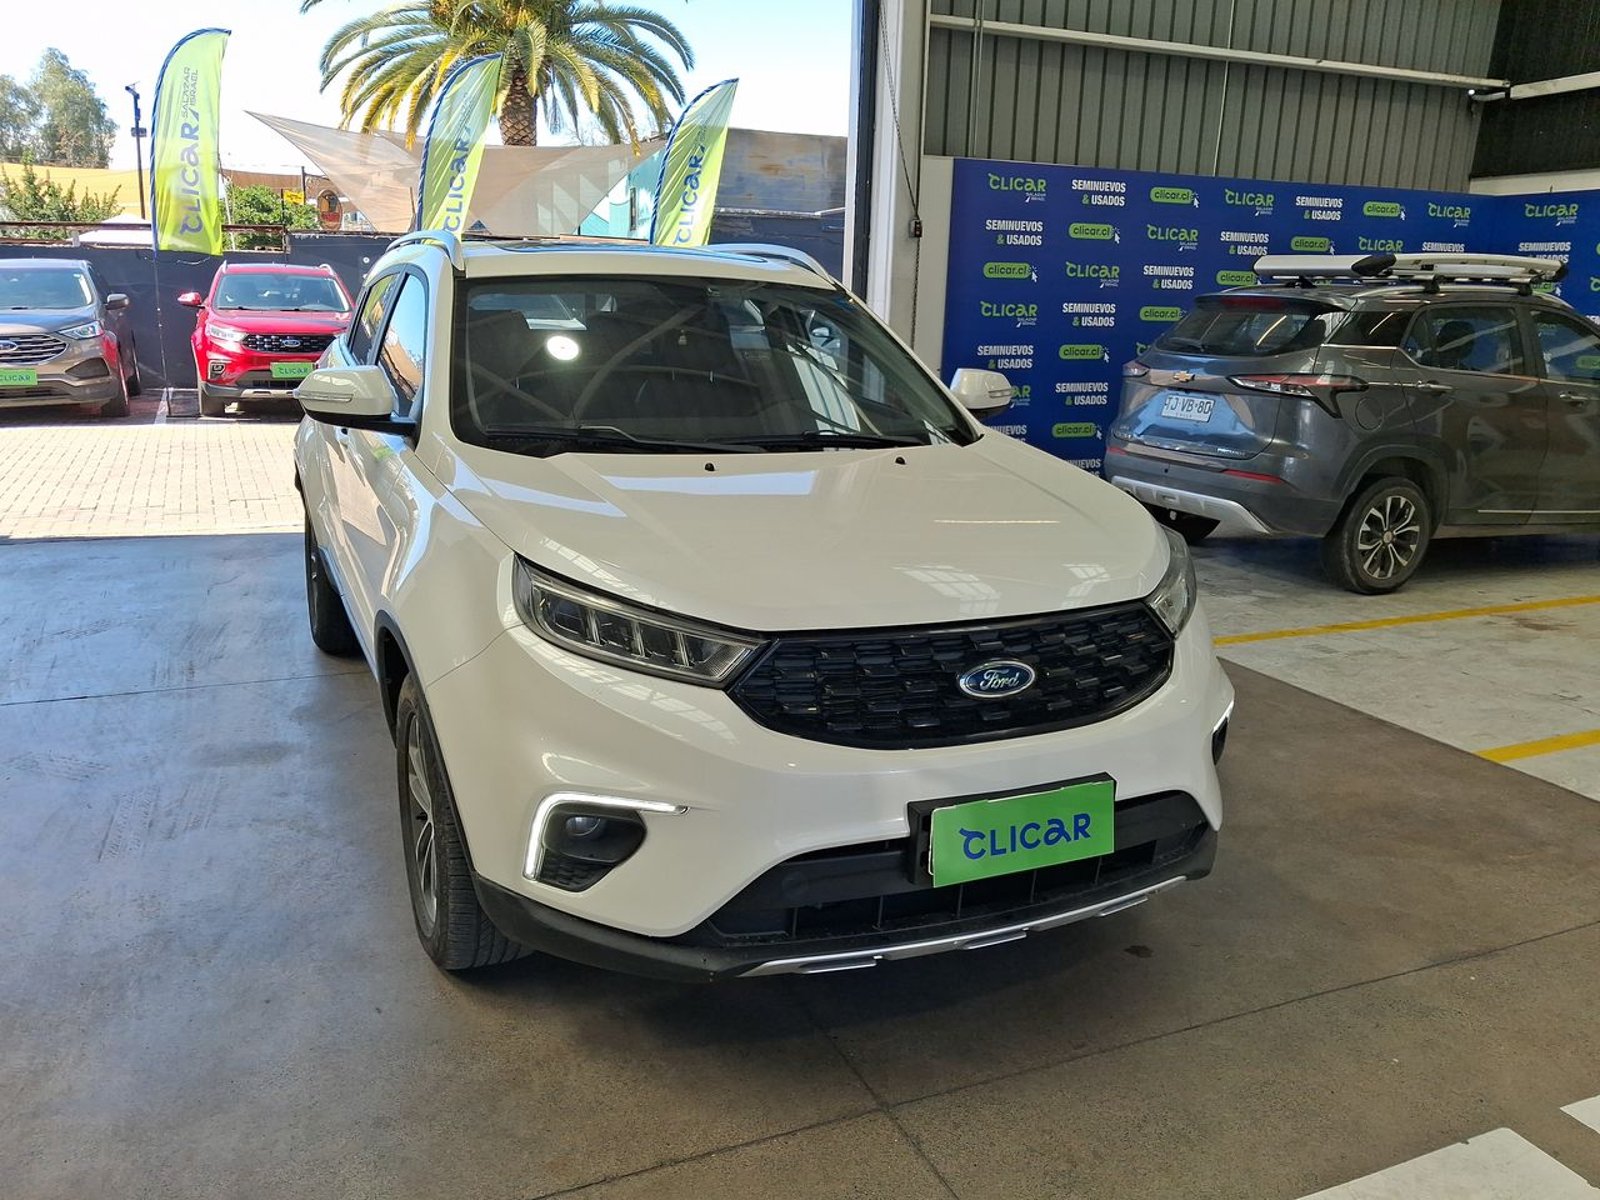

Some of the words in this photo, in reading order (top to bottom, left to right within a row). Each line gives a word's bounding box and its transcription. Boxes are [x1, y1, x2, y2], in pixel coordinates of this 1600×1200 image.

[1071, 179, 1127, 193] SEMINUEVOS
[1154, 189, 1190, 200] clicar.cl
[1091, 194, 1126, 207] USADOS
[1295, 196, 1343, 208] SEMINUEVOS
[1311, 210, 1341, 221] USADOS
[985, 219, 1044, 232] SEMINUEVOS
[1072, 225, 1111, 236] clicar.cl
[1006, 234, 1042, 246] USADOS
[1220, 231, 1270, 244] SEMINUEVOS
[1237, 245, 1268, 256] USADOS
[1422, 241, 1466, 253] SEMINUEVOS
[1518, 241, 1572, 252] SEMINUEVOS
[987, 264, 1027, 275] clicar.cl
[1143, 265, 1195, 277] SEMINUEVOS
[1220, 272, 1254, 283] clicar.cl
[1161, 279, 1193, 290] USADOS
[1062, 302, 1116, 314] SEMINUEVOS
[1143, 308, 1179, 319] clicar.cl
[1081, 317, 1115, 327] USADOS
[977, 345, 1034, 356] SEMINUEVOS
[1063, 346, 1100, 357] clicar.cl
[997, 358, 1033, 369] USADOS
[1055, 382, 1109, 393] SEMINUEVOS
[1074, 395, 1108, 405] USADOS
[1056, 425, 1092, 435] clicar.cl
[979, 668, 1020, 690] Ford
[959, 813, 1092, 860] CLICAR
